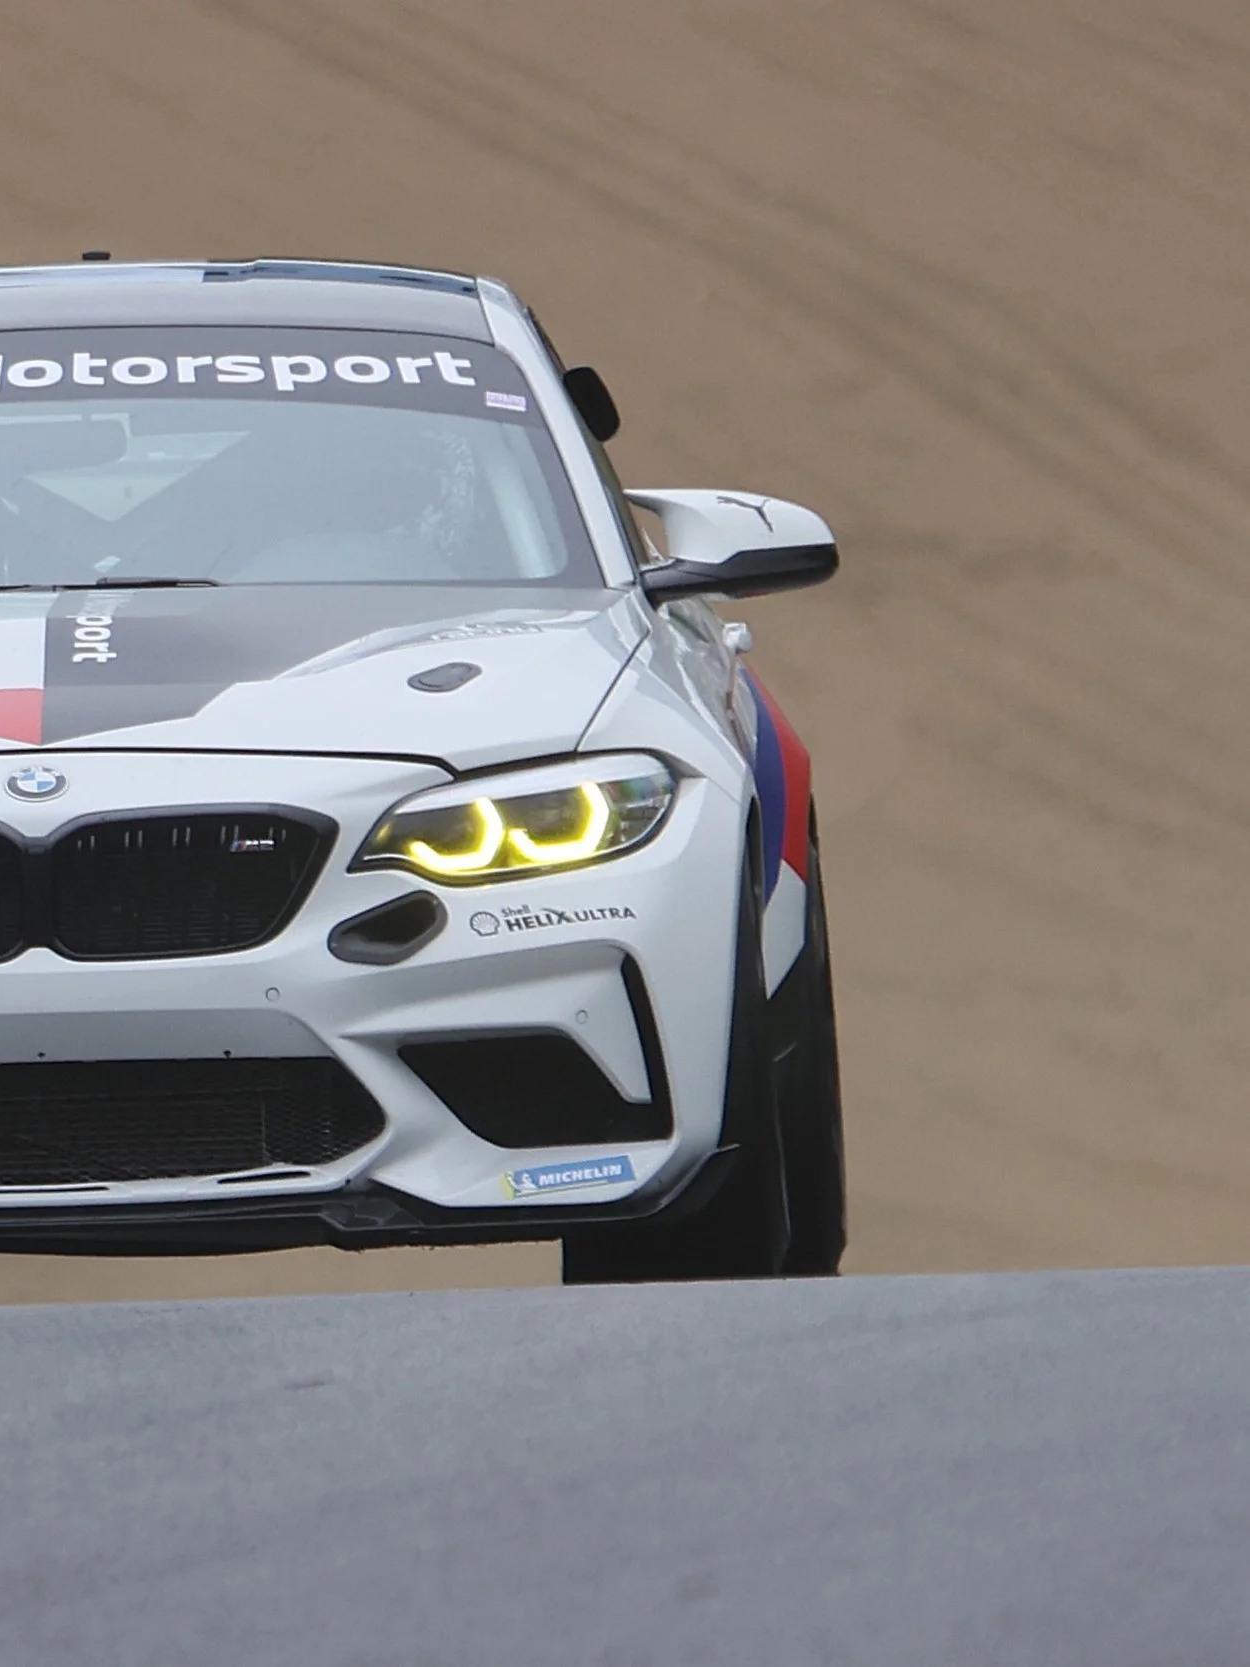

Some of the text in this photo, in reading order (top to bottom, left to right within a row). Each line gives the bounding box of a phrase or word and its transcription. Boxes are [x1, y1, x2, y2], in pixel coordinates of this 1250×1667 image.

[501, 904, 531, 917] Shell
[505, 906, 637, 932] HELIX ULTRA
[538, 1164, 623, 1186] MICHELIN
